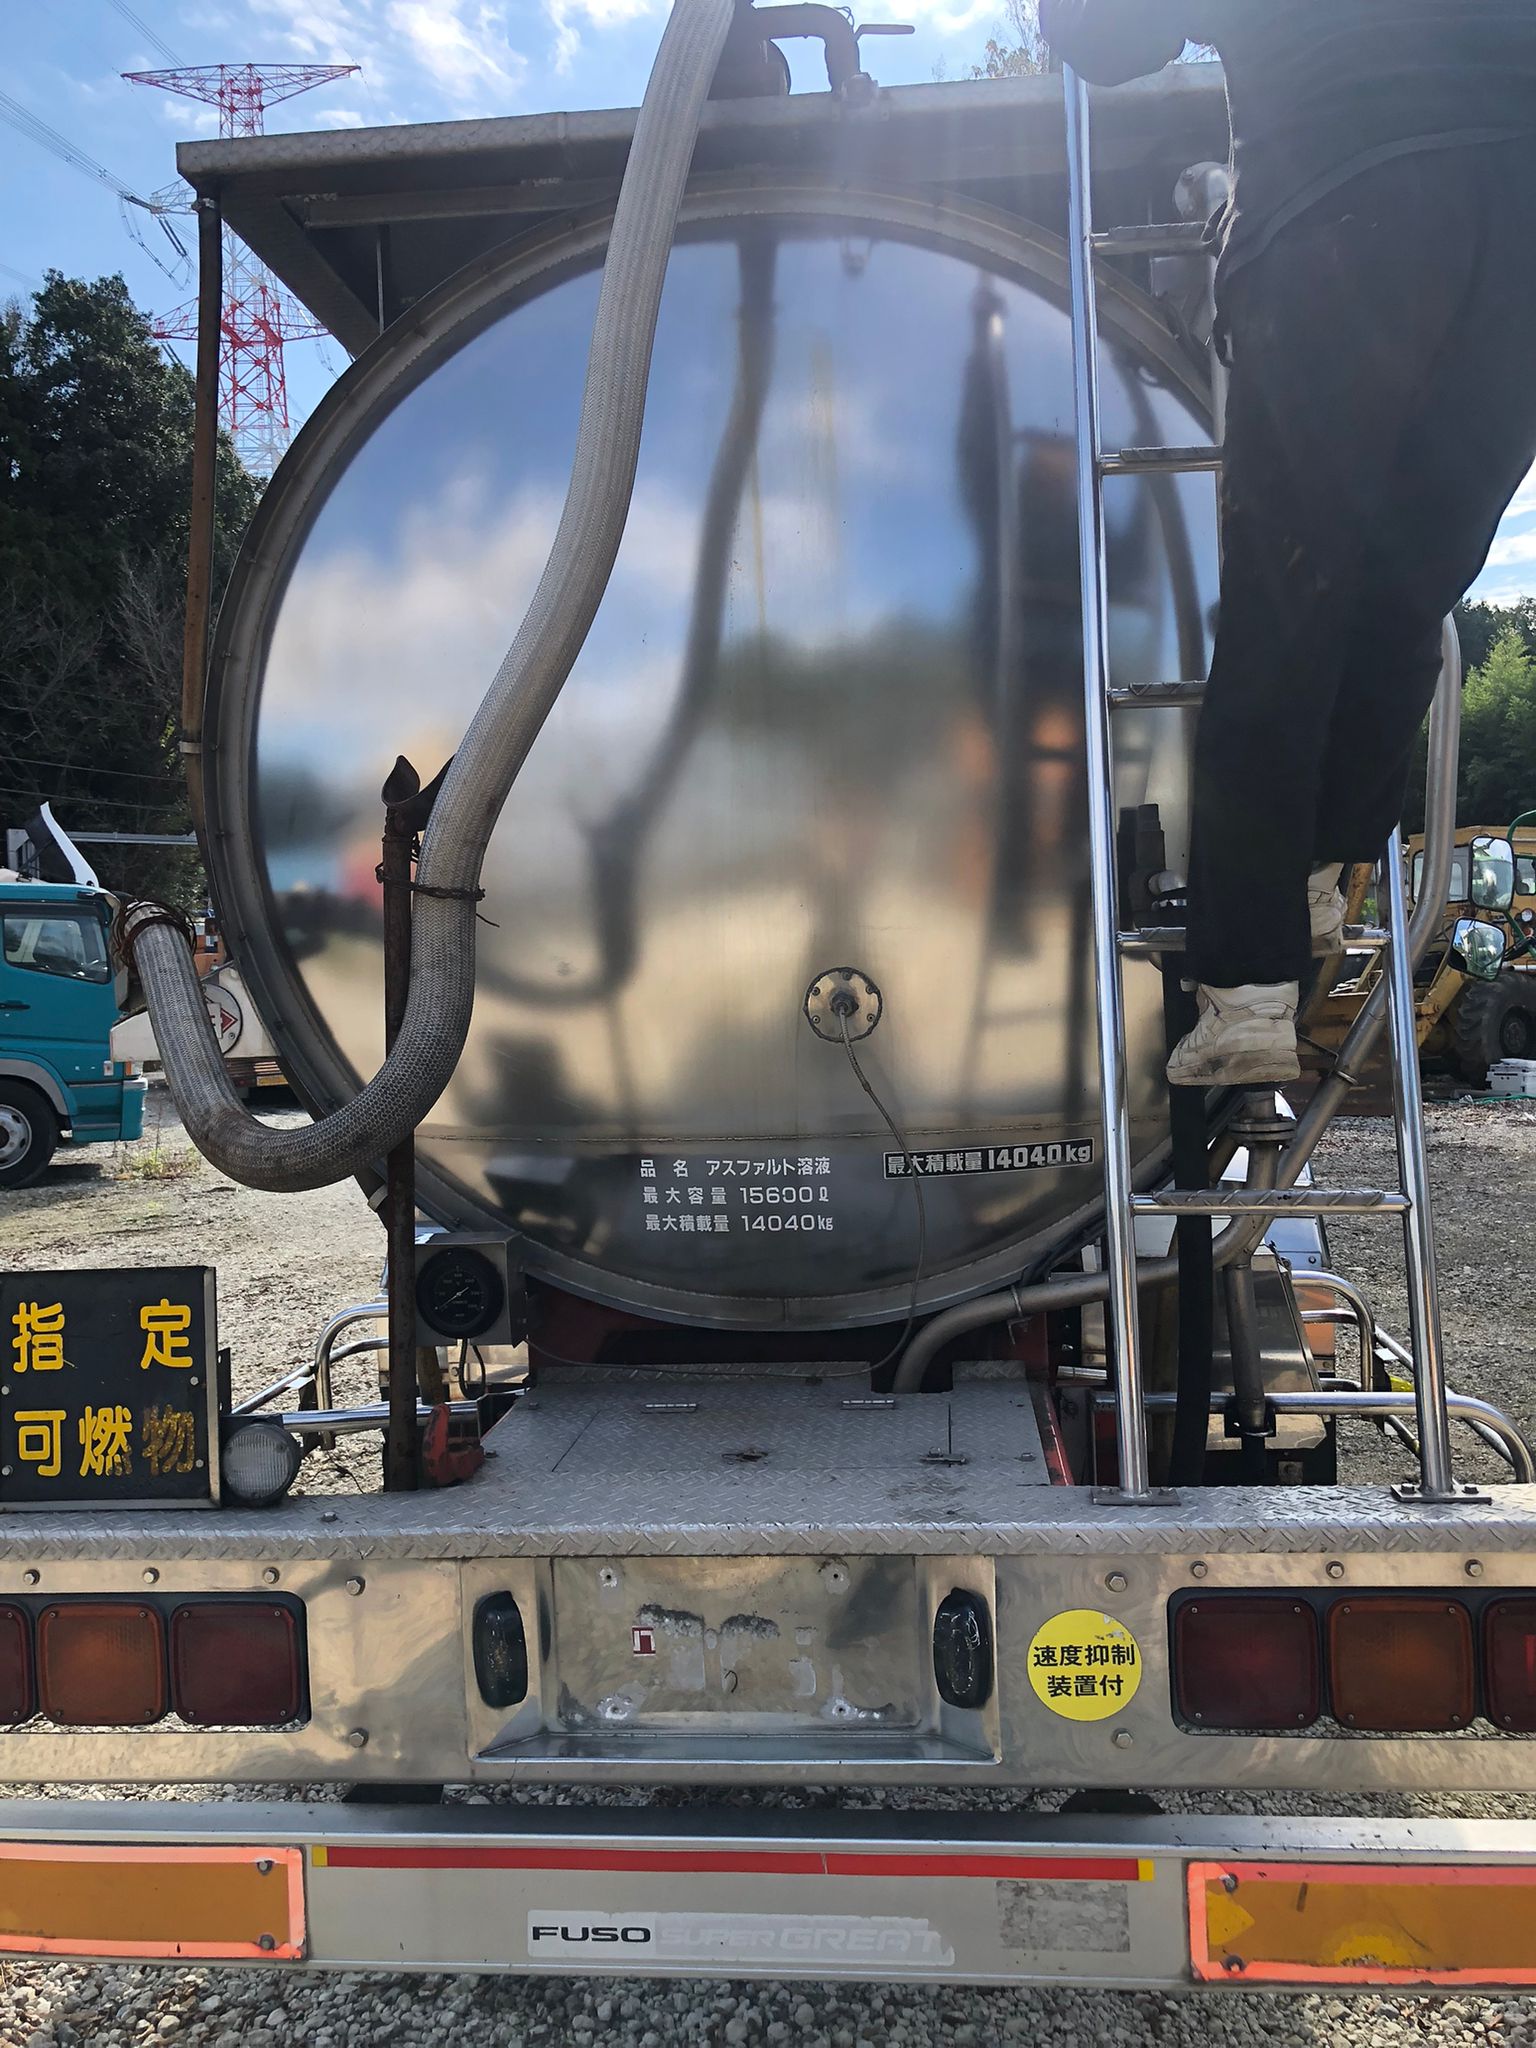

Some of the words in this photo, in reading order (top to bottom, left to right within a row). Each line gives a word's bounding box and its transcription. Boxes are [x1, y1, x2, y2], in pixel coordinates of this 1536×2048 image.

[706, 1156, 831, 1178] アスファルト溶液
[643, 1186, 727, 1205] 最大容量
[645, 1213, 730, 1232] 最大積載量
[741, 1214, 834, 1232] 14040kg
[12, 1298, 193, 1374] 指定
[14, 1403, 195, 1477] 可燃物
[1033, 1644, 1136, 1667] 速度抑制
[1047, 1674, 1124, 1698] 装置付
[532, 1926, 651, 1943] FUSO
[660, 1927, 776, 1948] SUPER
[779, 1926, 942, 1954] GREAT
